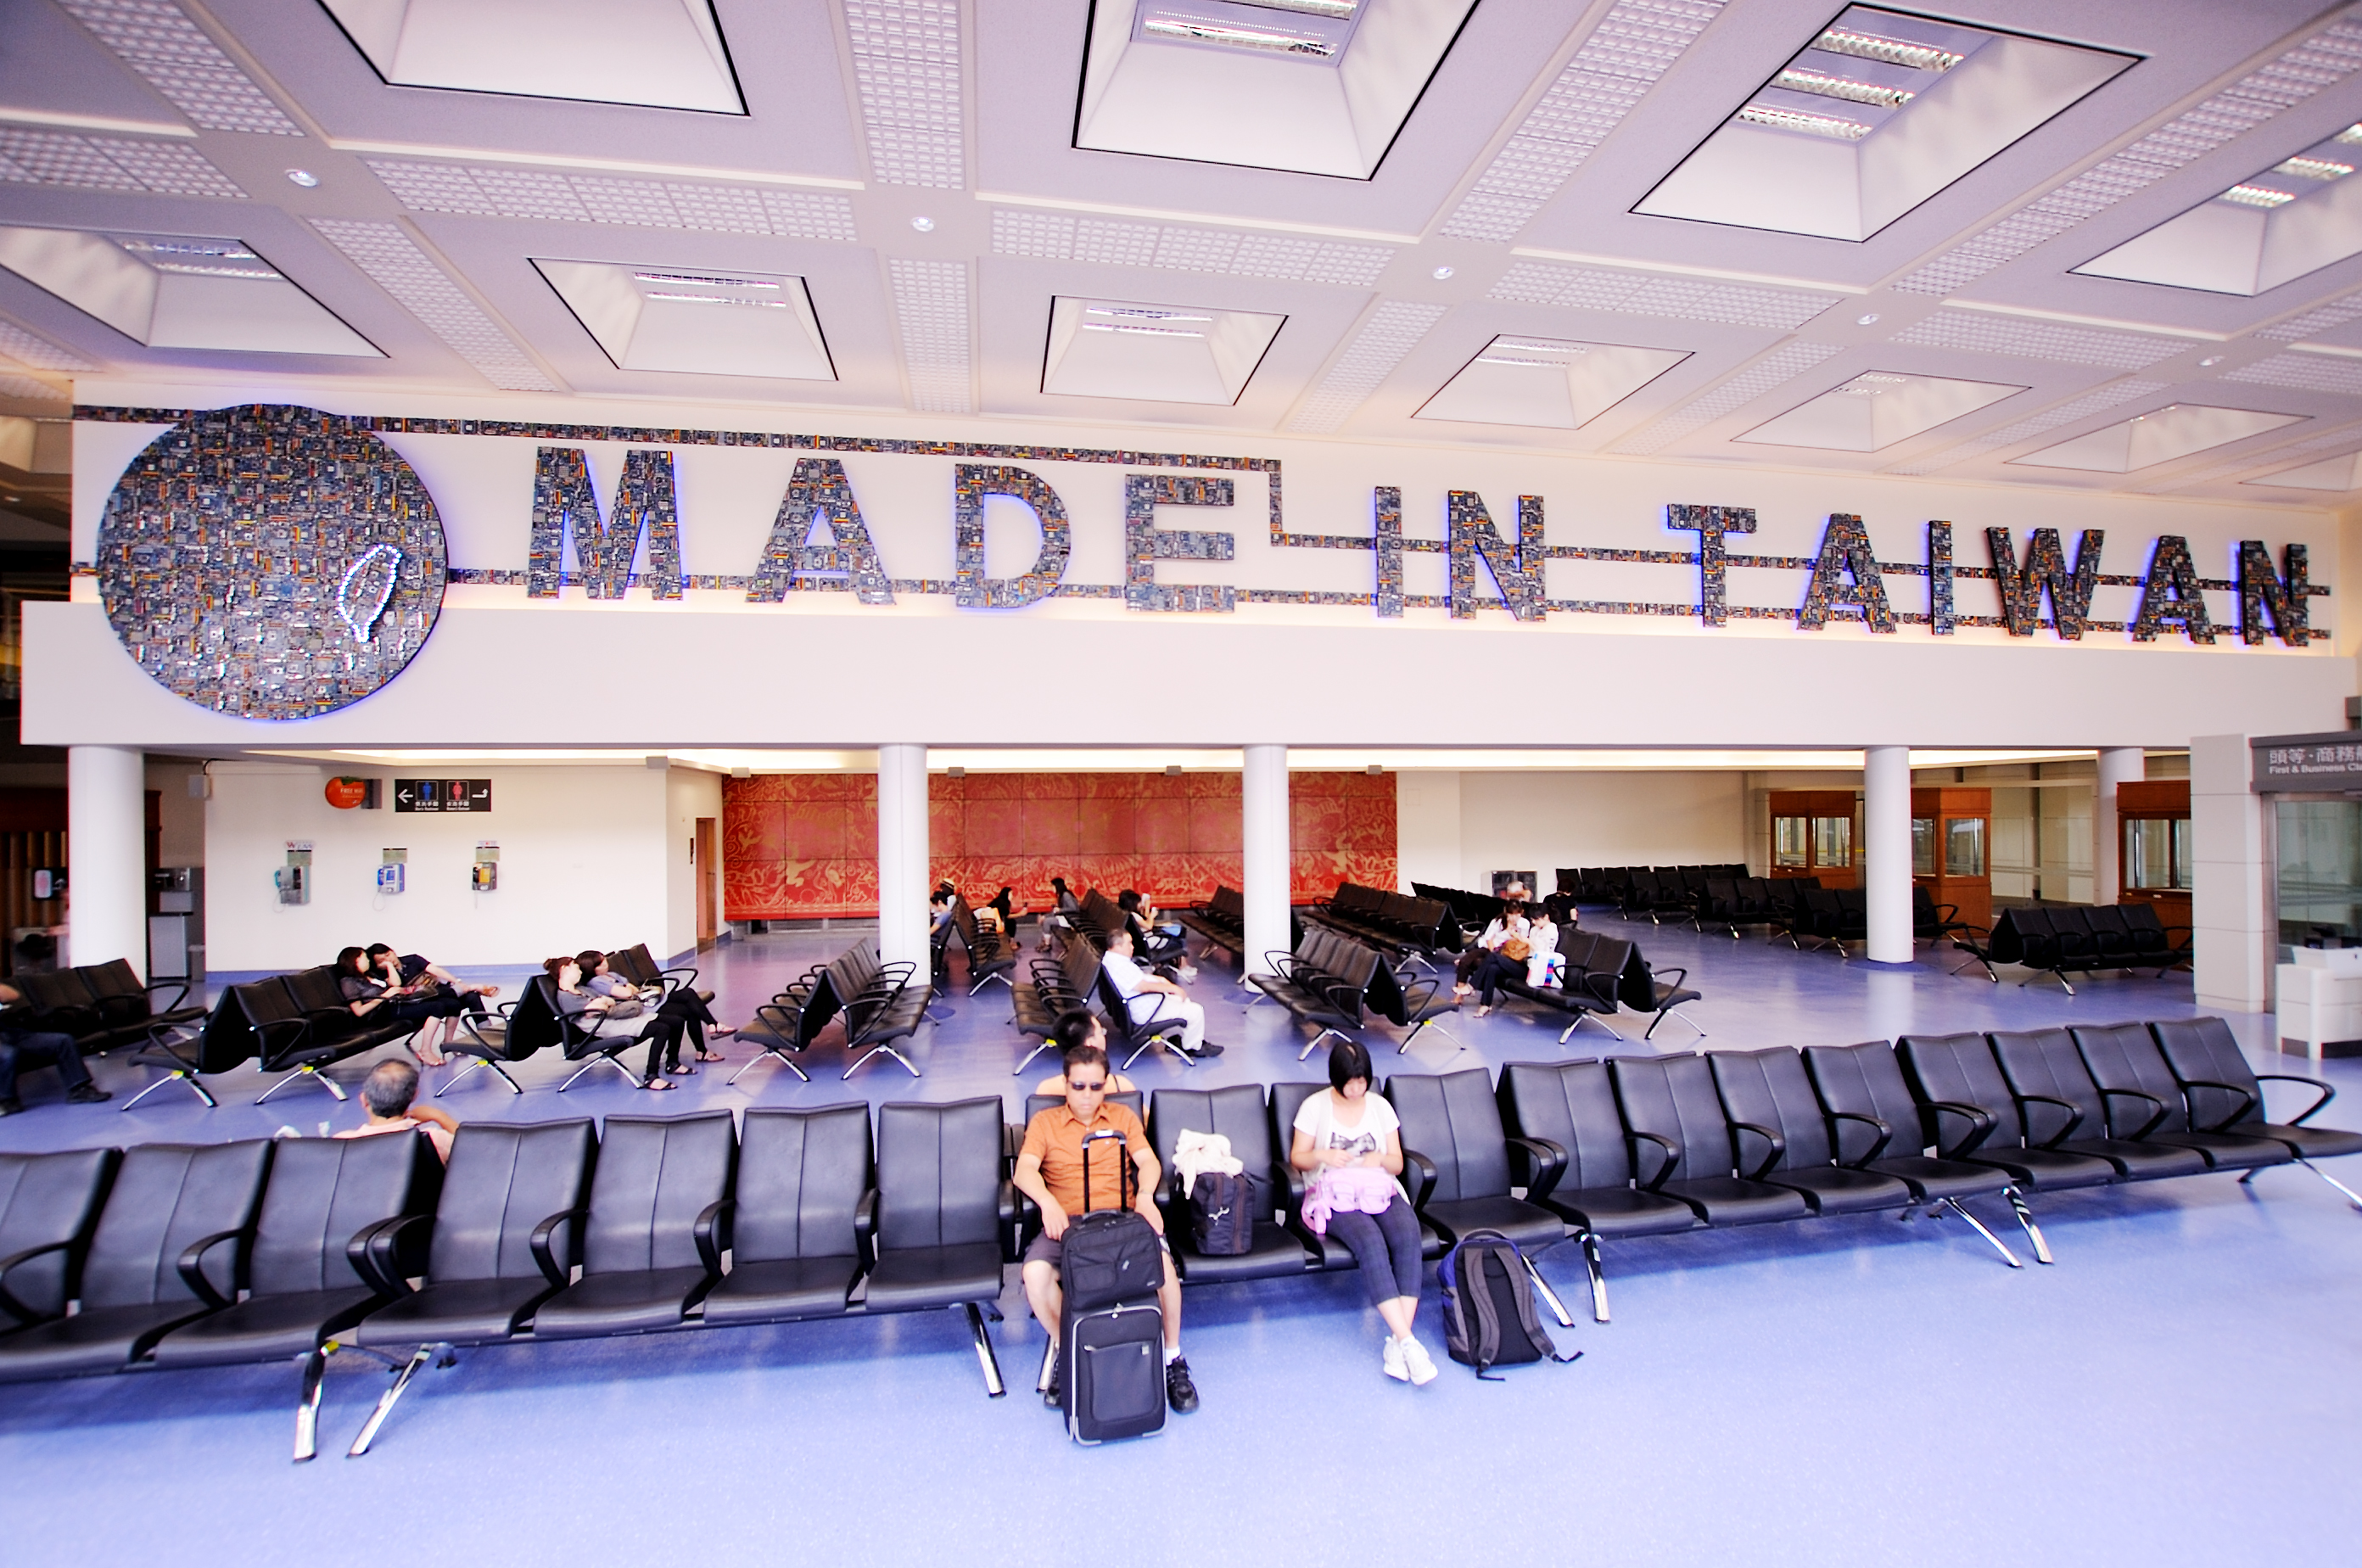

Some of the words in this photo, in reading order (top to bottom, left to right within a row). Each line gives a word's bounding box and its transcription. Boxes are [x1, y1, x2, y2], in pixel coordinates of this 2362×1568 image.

[526, 445, 1235, 613] MADE
[1374, 486, 1547, 623] IN
[1667, 504, 2309, 647] TAIWAN
[2269, 765, 2290, 774] First
[2301, 764, 2346, 773] Business
